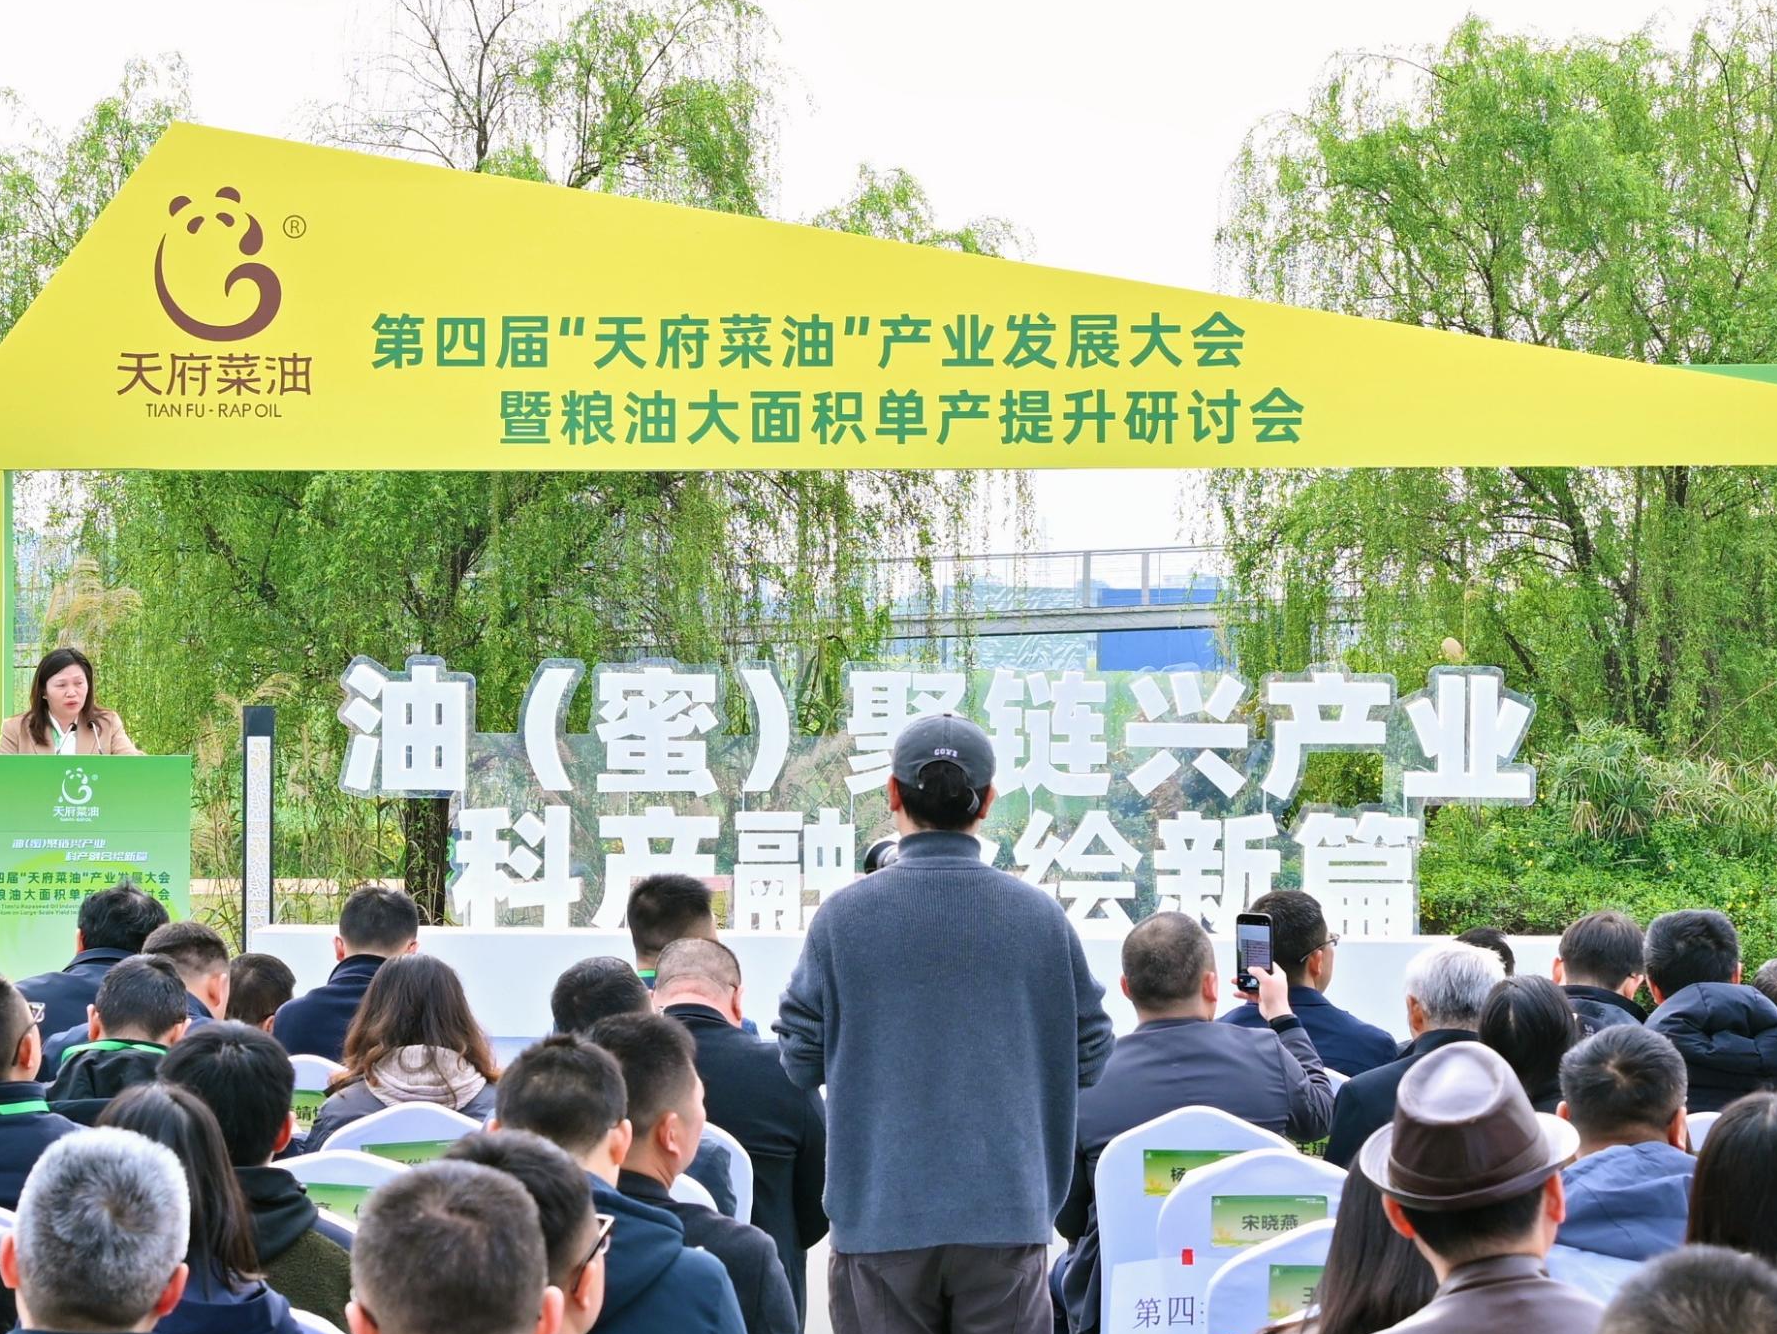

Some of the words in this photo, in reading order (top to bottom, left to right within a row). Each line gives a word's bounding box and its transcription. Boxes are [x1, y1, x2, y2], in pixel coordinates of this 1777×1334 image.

[370, 312, 1248, 370] 第四届“天府菜油”产业发展大会
[116, 352, 313, 397] 天府菜油
[499, 388, 1306, 445] 暨粮油大面积单产提升研讨会
[53, 806, 99, 817] 天府菜油
[453, 804, 1422, 931] 科产融绘新篇
[1241, 1214, 1299, 1231] 宋晓燕
[1132, 1296, 1204, 1329] 第四
